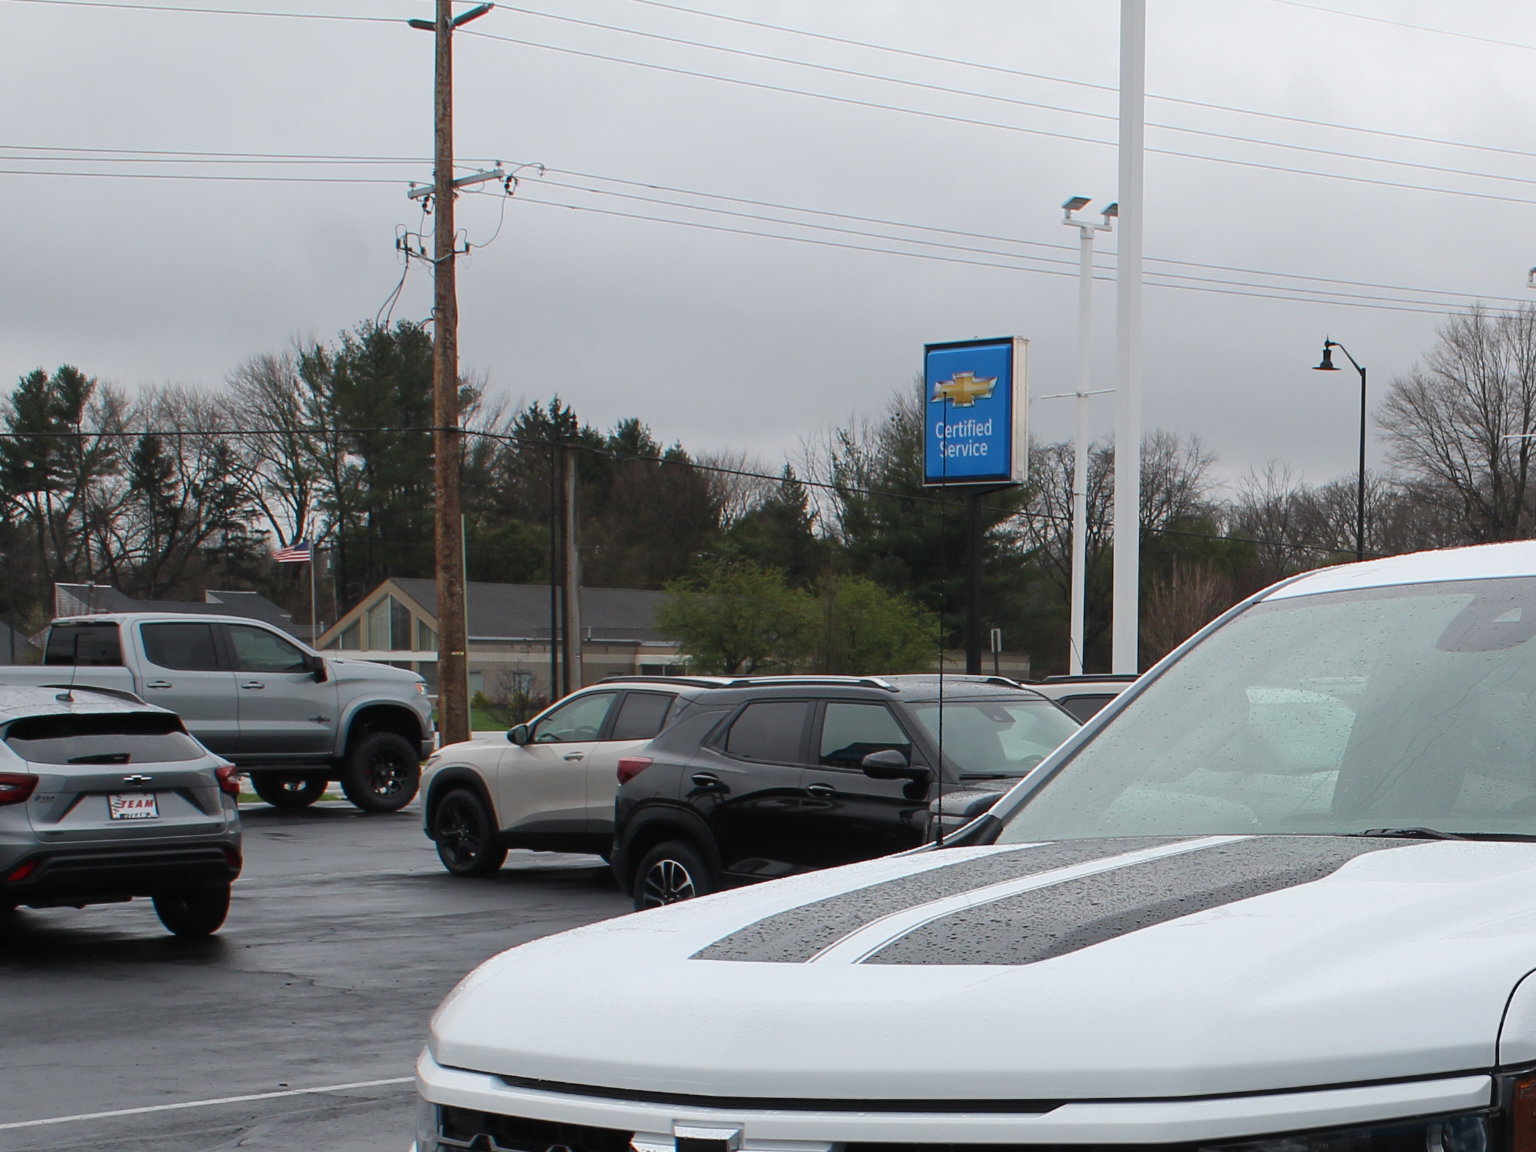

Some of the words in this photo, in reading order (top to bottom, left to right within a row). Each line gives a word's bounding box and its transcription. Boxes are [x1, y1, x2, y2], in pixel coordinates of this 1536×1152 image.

[935, 418, 992, 439] Certified
[939, 440, 988, 458] Service
[120, 799, 154, 809] TEAM
